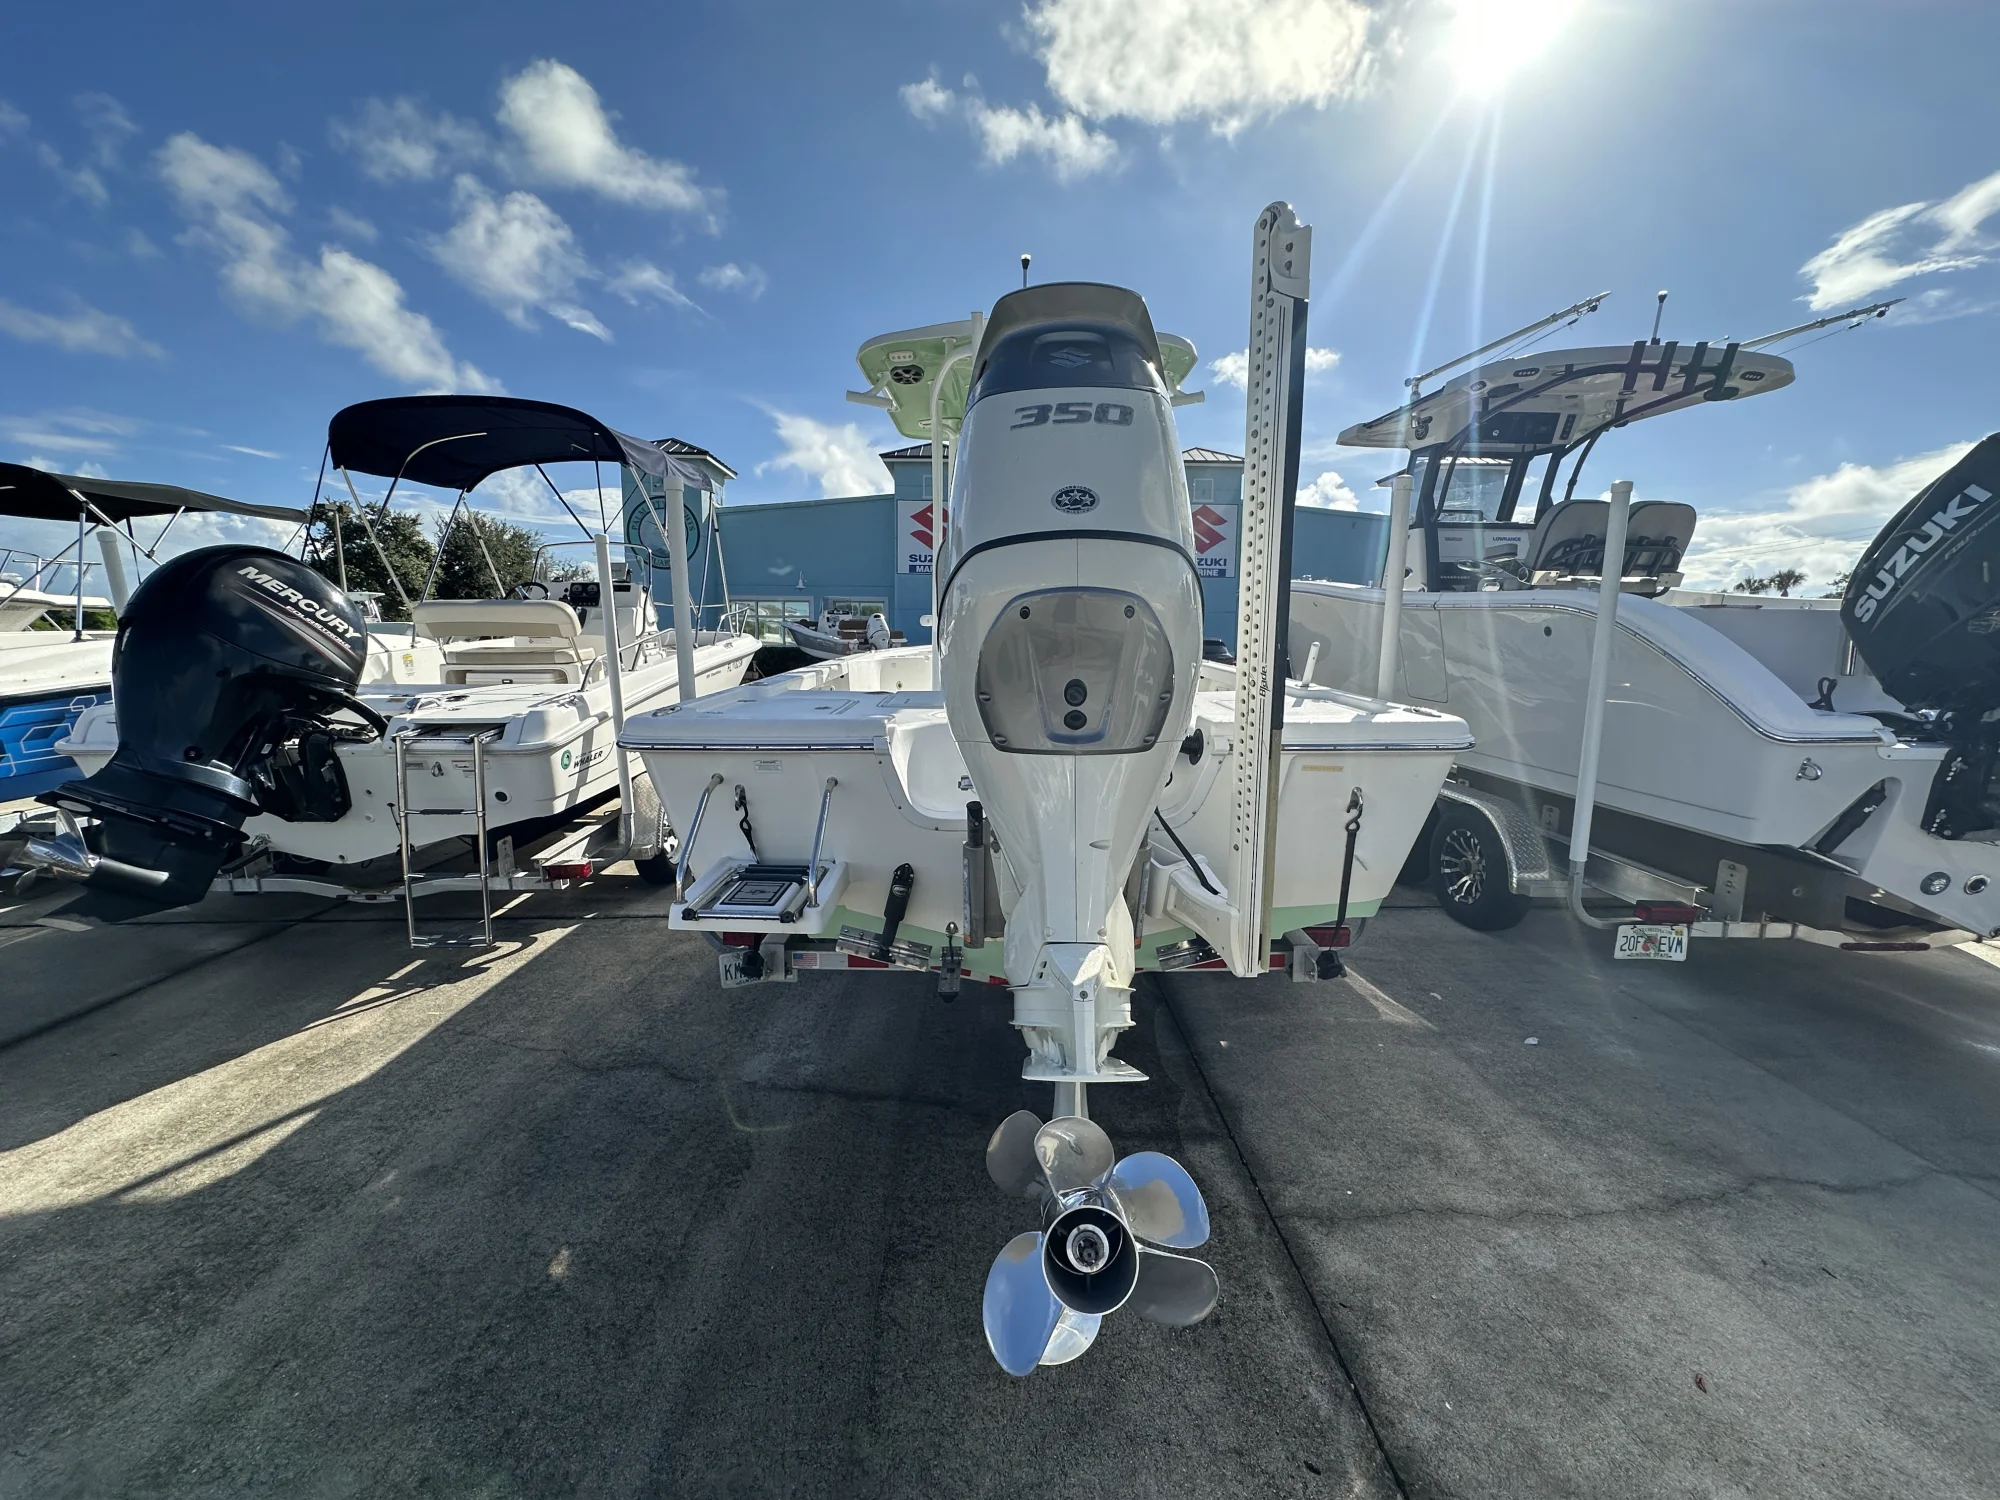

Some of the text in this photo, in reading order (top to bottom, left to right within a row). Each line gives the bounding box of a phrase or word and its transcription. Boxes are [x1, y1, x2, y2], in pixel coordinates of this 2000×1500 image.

[1009, 401, 1135, 432] 350
[908, 554, 933, 563] SUZ
[1196, 557, 1227, 567] ZUKI
[1853, 483, 1993, 623] SUZUKI
[236, 566, 363, 639] MERCURY
[573, 750, 603, 769] WHALER
[1657, 936, 1683, 954] EVM
[724, 962, 743, 981] KM
